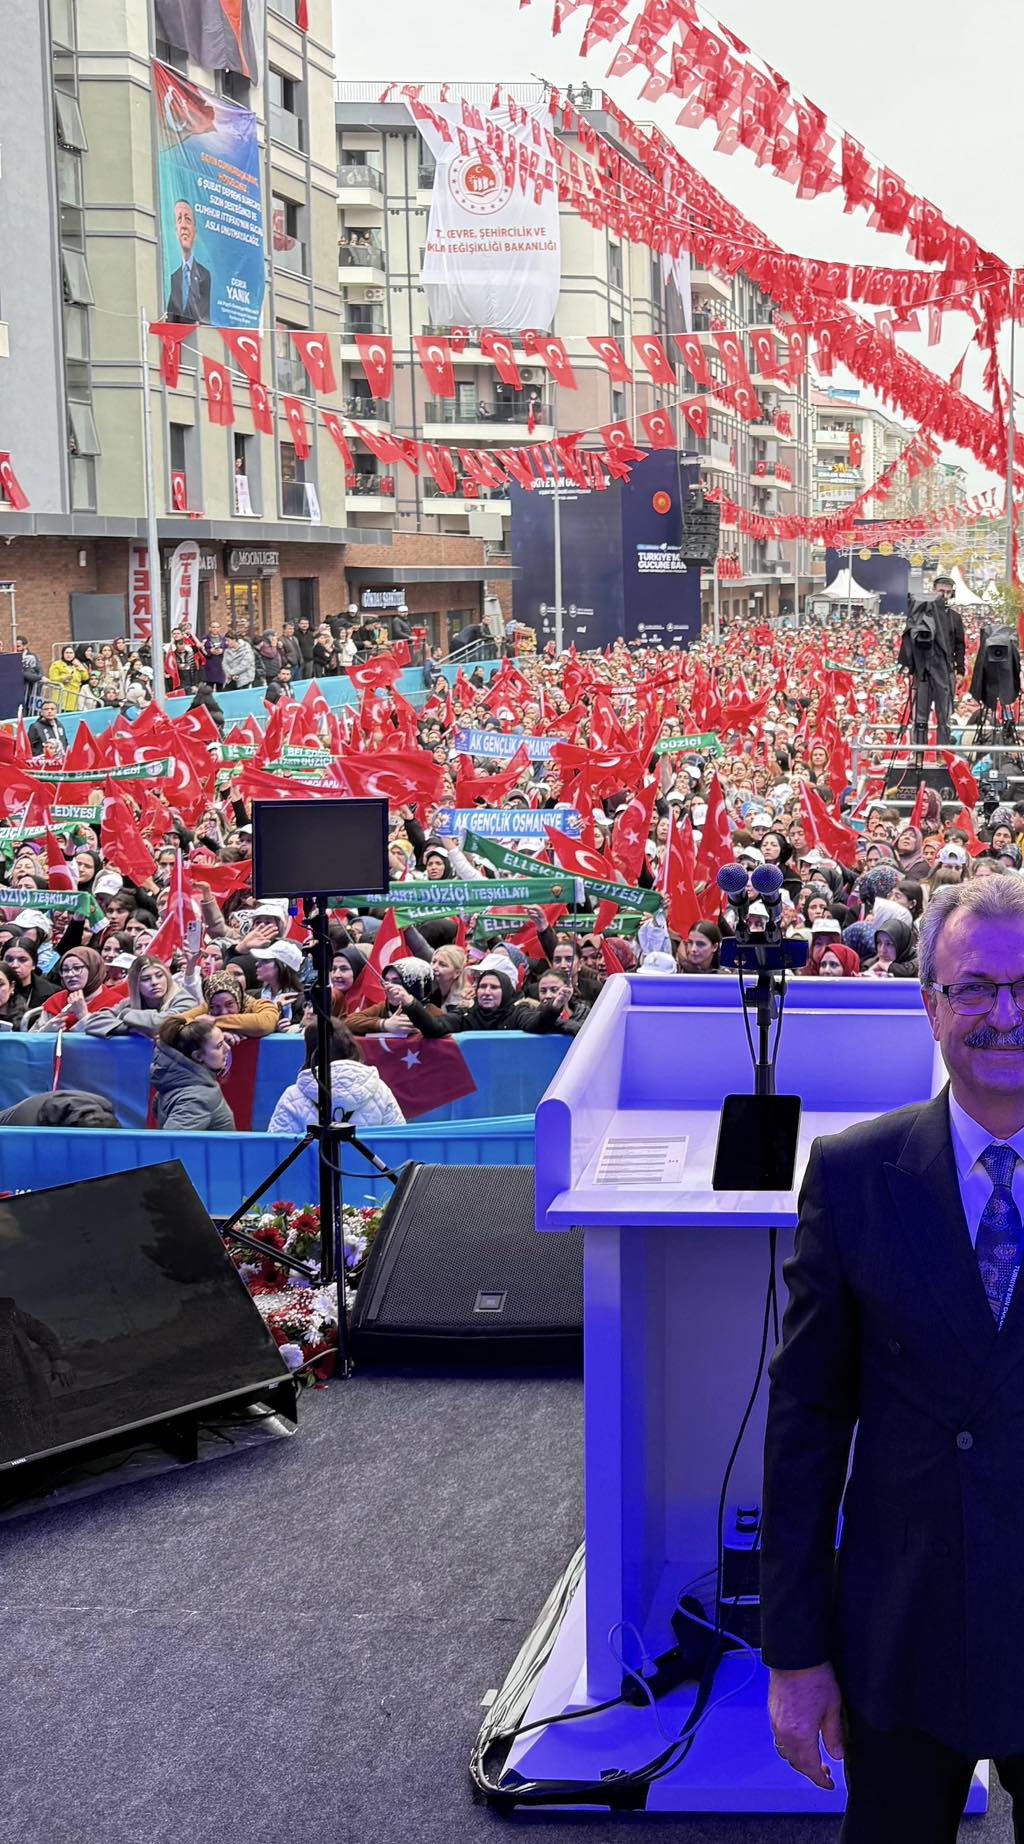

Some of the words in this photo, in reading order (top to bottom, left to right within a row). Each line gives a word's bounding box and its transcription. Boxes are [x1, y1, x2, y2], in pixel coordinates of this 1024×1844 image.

[480, 225, 534, 240] ŞEHİRCİLİK
[534, 226, 547, 237] VE
[504, 239, 557, 251] BAKANLIĞI
[239, 551, 280, 566] MOONLIGHT
[469, 733, 482, 750] AK
[483, 735, 517, 756] GENÇLİK
[660, 736, 702, 750] DÜZİÇİ
[454, 812, 468, 831] AK
[470, 811, 511, 834] GENÇLİK
[512, 811, 562, 833] OSMANİYE
[32, 891, 79, 906] TEŞKİLATI
[421, 884, 470, 906] DÜZİÇİ
[471, 884, 530, 903] TEŞKİLATI
